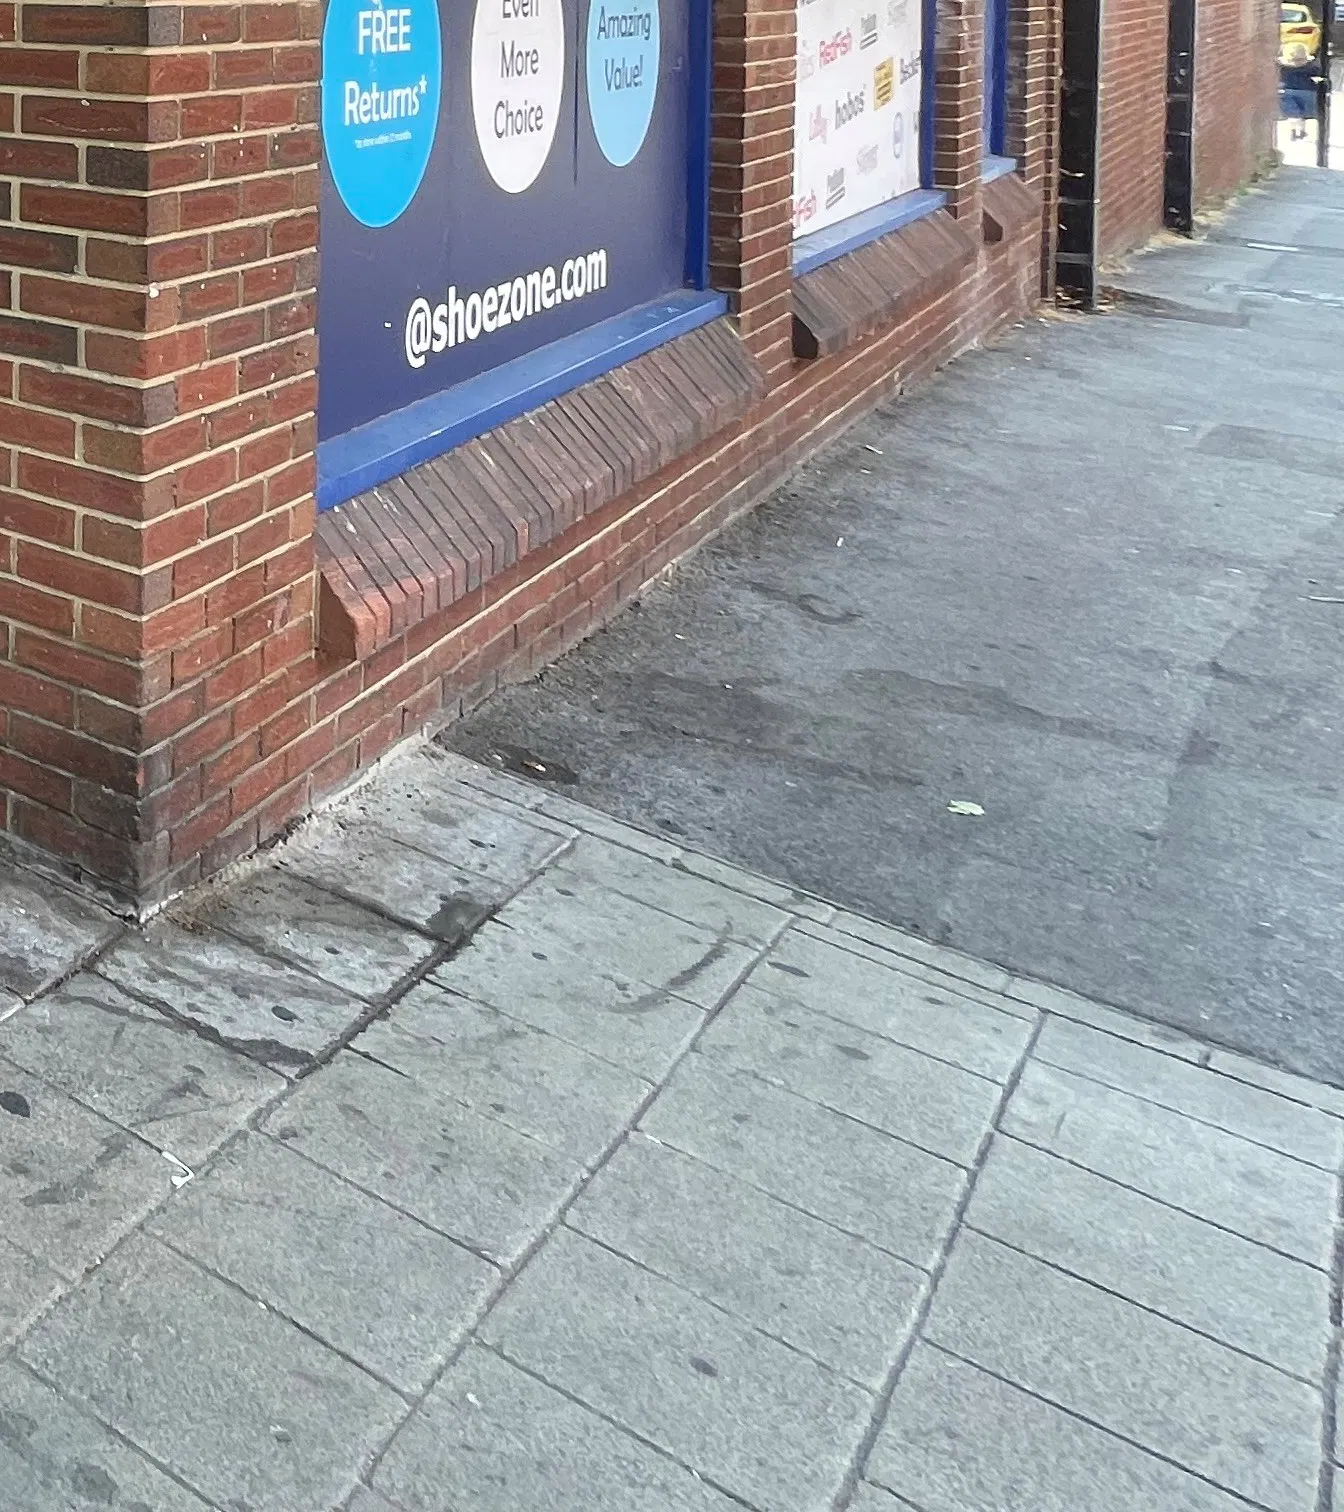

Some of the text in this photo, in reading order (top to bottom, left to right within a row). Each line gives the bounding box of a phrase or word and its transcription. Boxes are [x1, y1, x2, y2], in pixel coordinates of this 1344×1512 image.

[357, 7, 412, 56] FREE
[596, 4, 652, 42] Amazing
[500, 41, 540, 79] More
[604, 56, 644, 92] Value!
[493, 99, 545, 139] Choice
[404, 247, 608, 369] @shoezone.com
